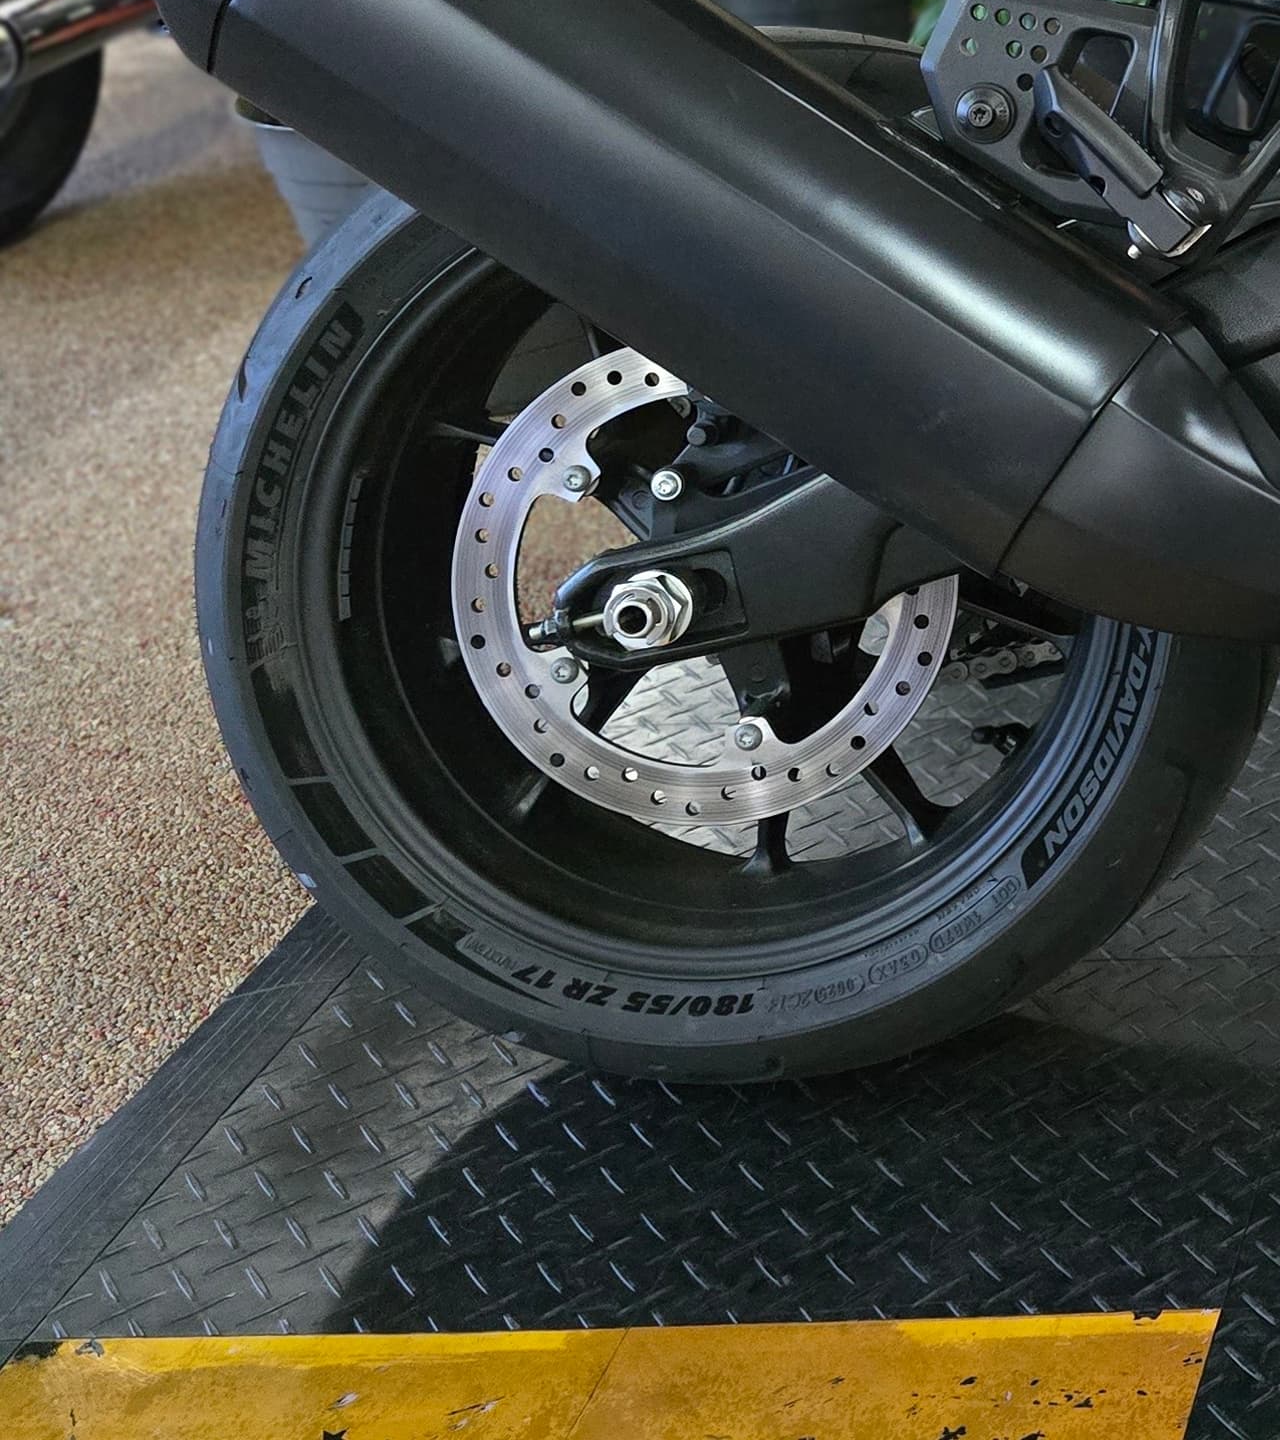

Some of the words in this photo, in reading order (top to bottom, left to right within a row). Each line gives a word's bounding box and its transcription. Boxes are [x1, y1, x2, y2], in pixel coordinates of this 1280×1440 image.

[245, 318, 355, 581] MICHELIN
[510, 963, 558, 993] 17
[563, 975, 621, 1006] ZR
[622, 990, 756, 1017] 180/55
